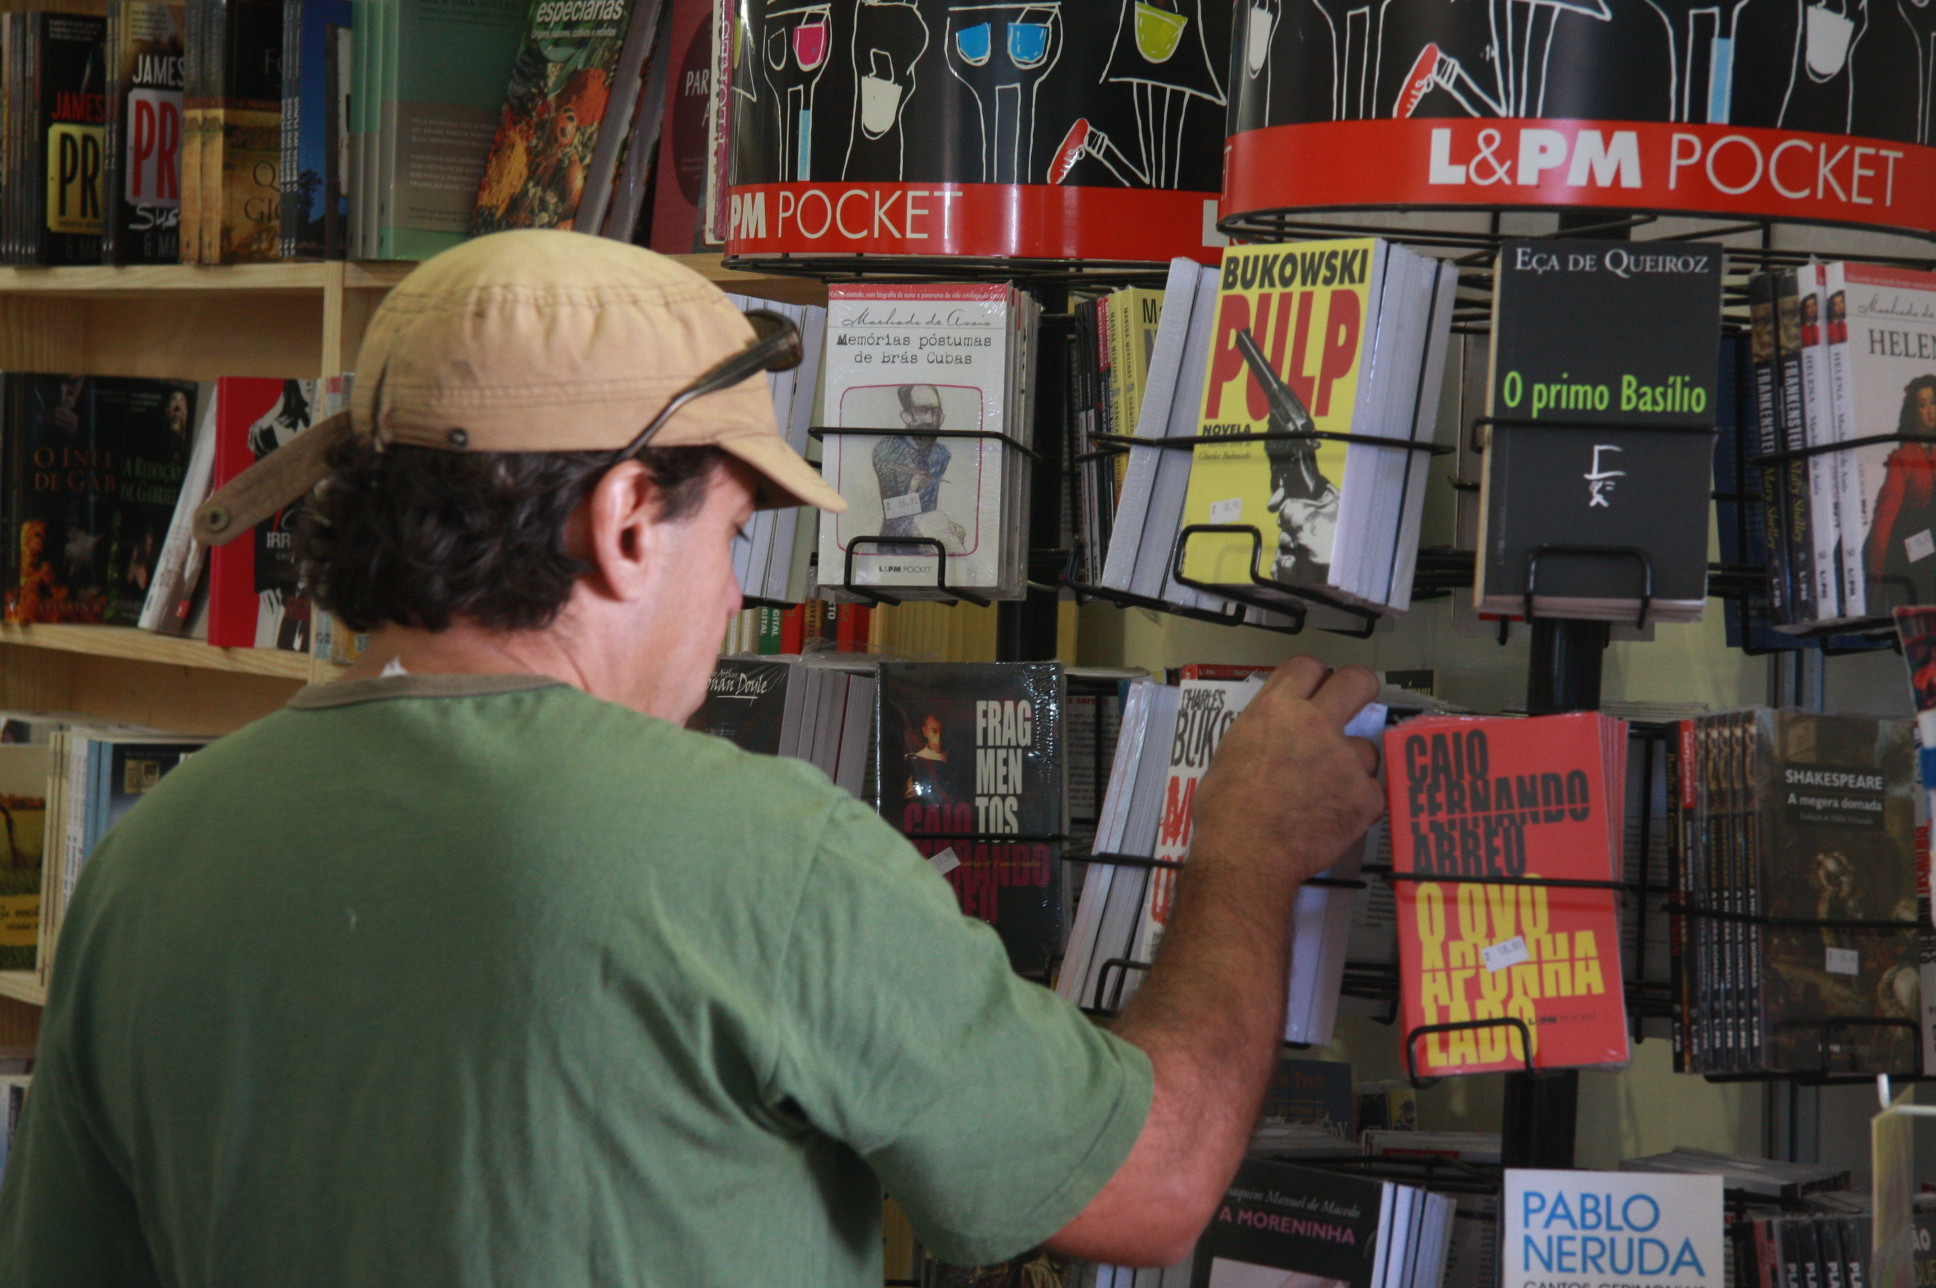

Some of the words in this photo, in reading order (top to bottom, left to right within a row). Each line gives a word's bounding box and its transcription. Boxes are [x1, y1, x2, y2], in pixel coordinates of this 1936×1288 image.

[536, 0, 624, 27] especiarias
[132, 54, 184, 87] JAMES
[51, 91, 104, 122] JAMES
[1429, 127, 1642, 189] L&PM
[1668, 132, 1904, 207] POCKET
[727, 192, 767, 239] PM
[778, 189, 963, 239] POCKET
[1222, 248, 1370, 291] BUKOWSKI
[1568, 253, 1598, 272] DE
[1604, 248, 1709, 278] QUEIROZ
[836, 333, 911, 347] Memórias
[919, 333, 992, 350] póstumas
[853, 350, 873, 364] de
[881, 351, 918, 364] Brás
[927, 351, 973, 365] Cubas
[1204, 288, 1361, 423] PULP
[1503, 370, 1522, 407] O
[1532, 372, 1609, 418] primo
[1620, 374, 1707, 413] Basílio
[706, 677, 734, 692] onan
[735, 671, 768, 698] Doyle
[1182, 688, 1226, 712] CHARLES
[976, 699, 1032, 747] FRAG
[976, 748, 1023, 796] MEN
[1405, 729, 1490, 786] CAIO
[1409, 769, 1590, 822] FERNANDO
[1785, 769, 1884, 790] SHAKESPEARE
[975, 795, 1019, 844] TOS
[1787, 792, 1798, 805] A
[1799, 796, 1839, 810] megera
[1841, 797, 1882, 812] domada
[1424, 995, 1540, 1067] LADO
[1218, 1207, 1233, 1224] A
[1237, 1209, 1356, 1246] MORENINHA
[1523, 1191, 1660, 1232] PABLO
[1523, 1234, 1706, 1277] NERUDA
